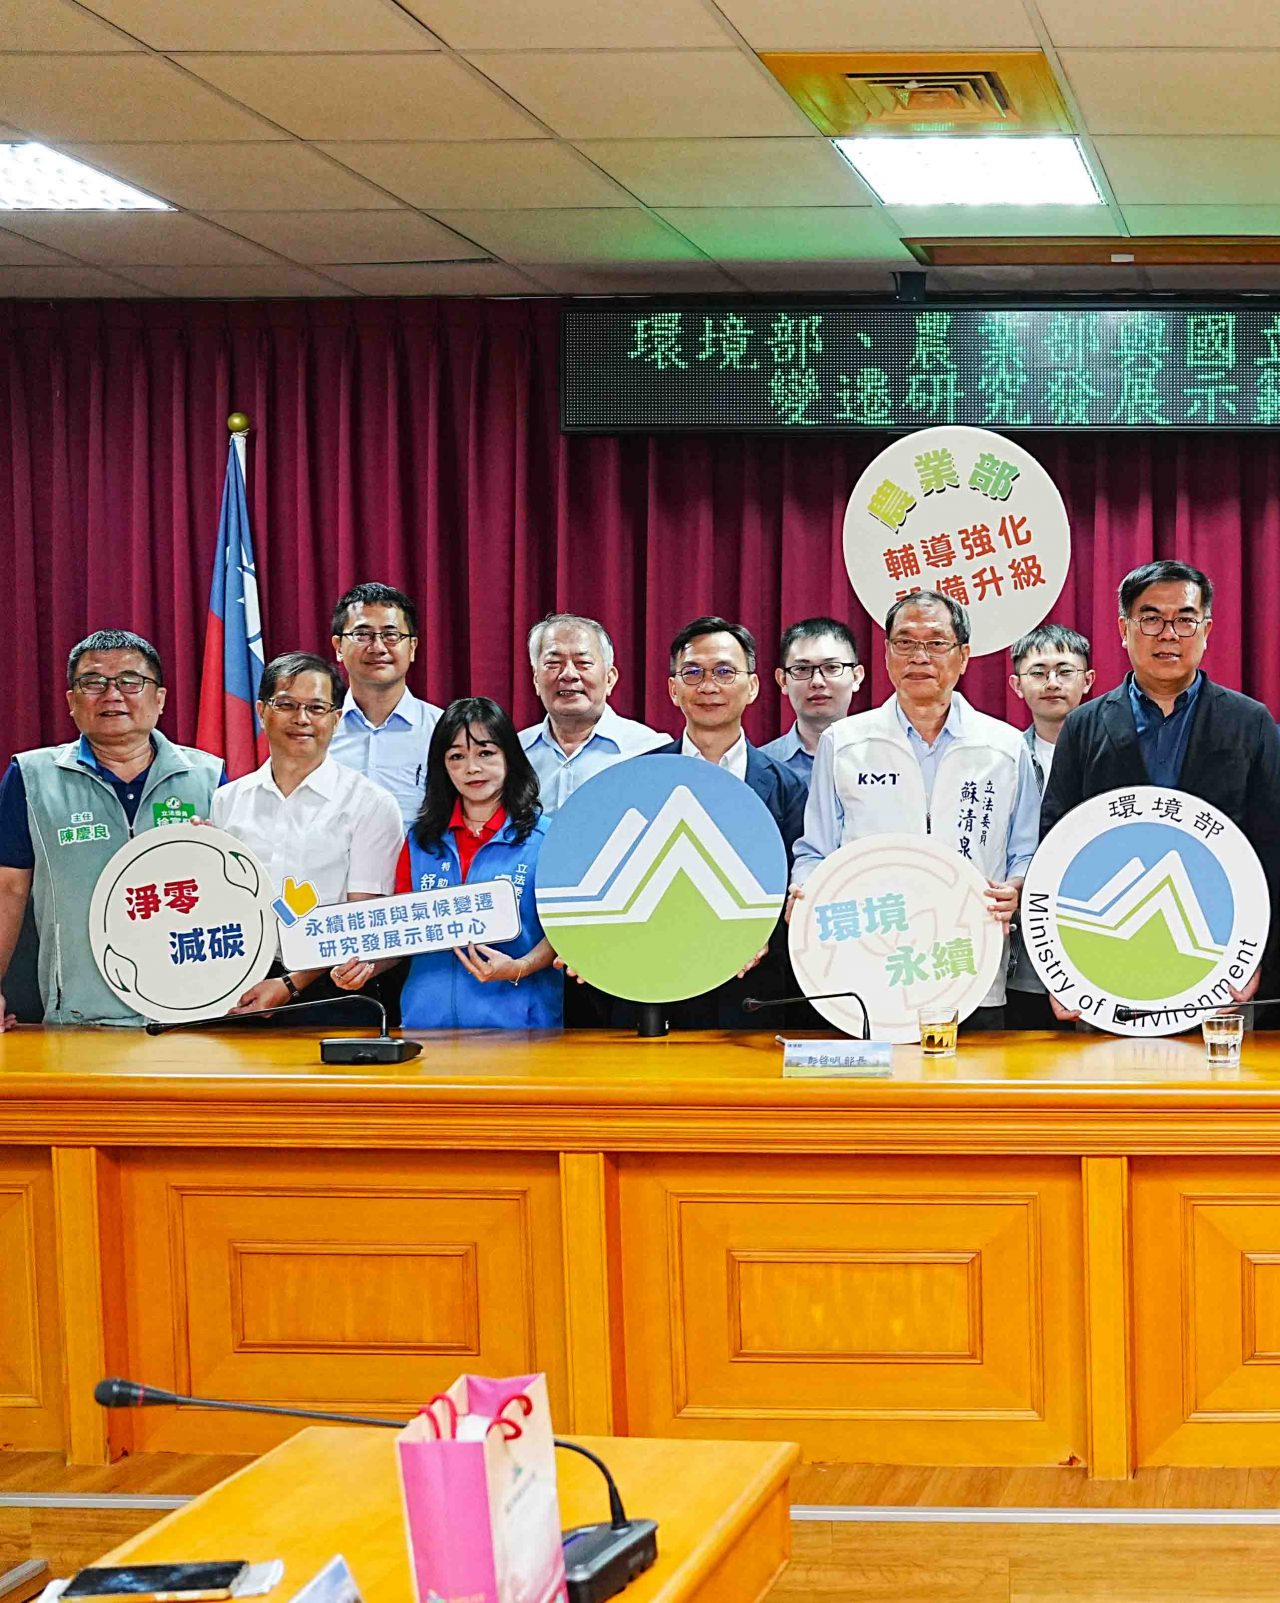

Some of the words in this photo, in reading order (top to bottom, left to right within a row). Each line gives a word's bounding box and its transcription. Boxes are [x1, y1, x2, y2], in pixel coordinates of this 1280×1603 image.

[867, 448, 1020, 534] 農業部
[883, 515, 1032, 581] 輔導強化
[858, 773, 900, 785] KMT
[58, 824, 110, 845] 陳慶良
[72, 812, 93, 823] 主任
[957, 781, 980, 860] 蘇清泉
[979, 780, 995, 846] 立法委員
[1108, 794, 1225, 839] 環境部
[125, 879, 199, 920] 淨零
[305, 892, 494, 937] 永續能源與氣候變遷
[815, 893, 909, 941] 環境
[169, 923, 245, 965] 減碳
[318, 918, 487, 958] 研究發展示範中心
[1028, 893, 1075, 994] Ministry
[1078, 994, 1106, 1016] of
[885, 937, 978, 988] 永續
